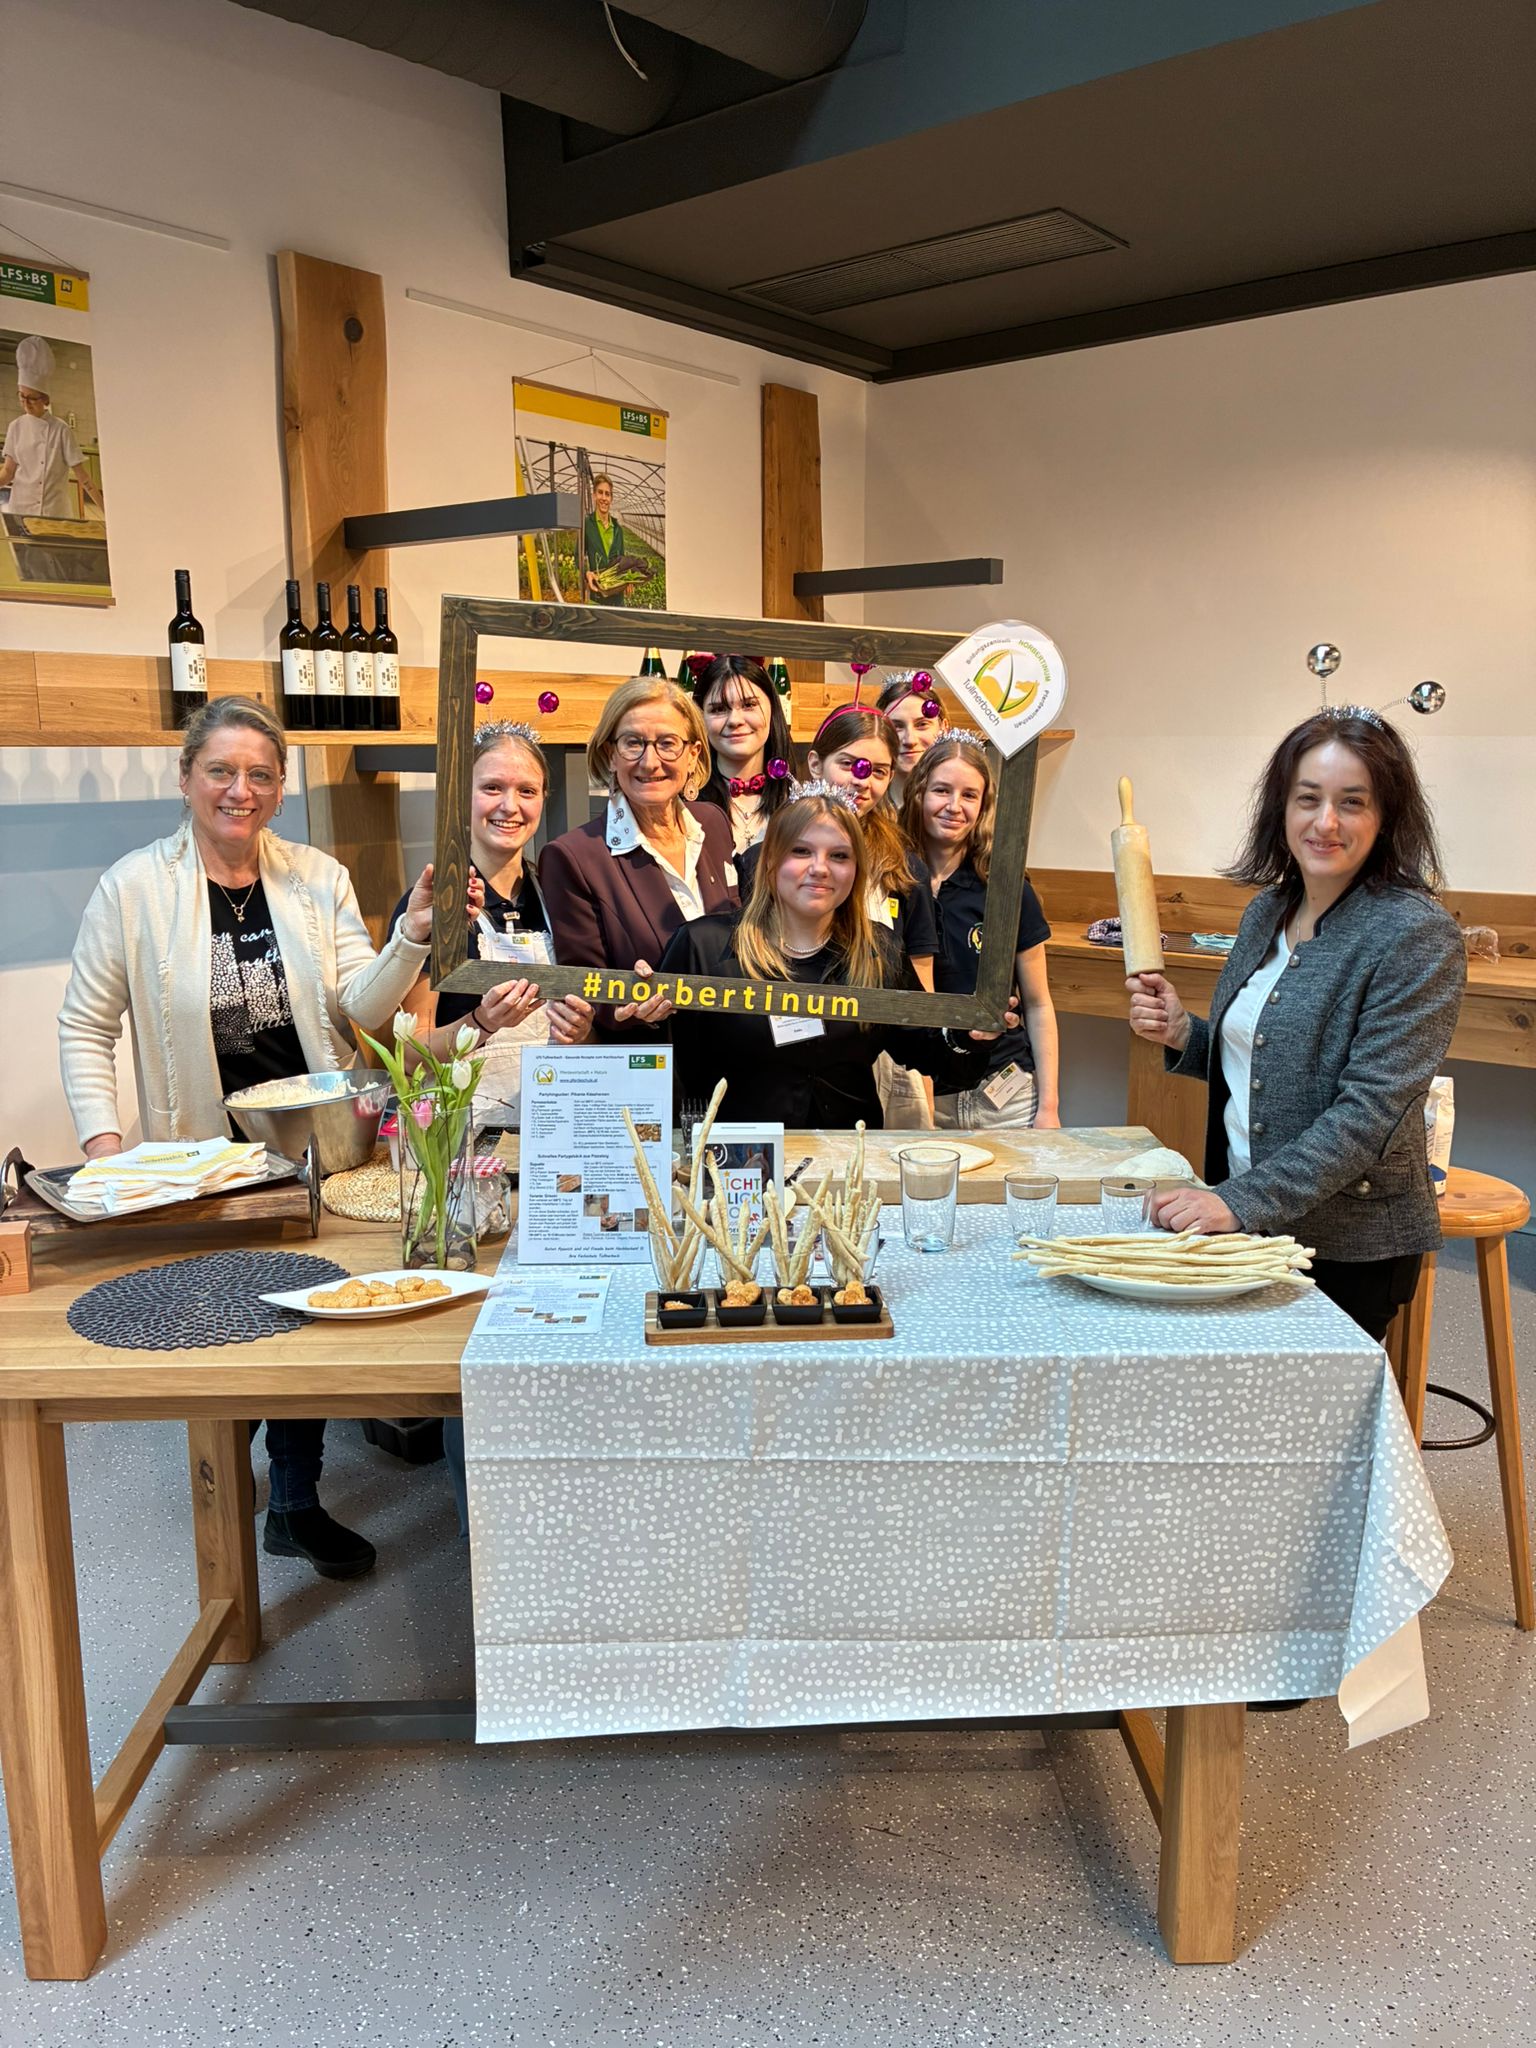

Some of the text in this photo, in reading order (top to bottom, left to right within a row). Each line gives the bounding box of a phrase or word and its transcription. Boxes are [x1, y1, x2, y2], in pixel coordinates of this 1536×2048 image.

[0, 266, 48, 286] LFS+BS
[622, 411, 648, 424] LFS+BS
[1018, 639, 1052, 683] NORBERTINUM
[962, 677, 1001, 727] Tullnerbach
[583, 971, 860, 1018] #norbertinum
[722, 1177, 761, 1191] ICHT
[727, 1192, 761, 1205] LICK
